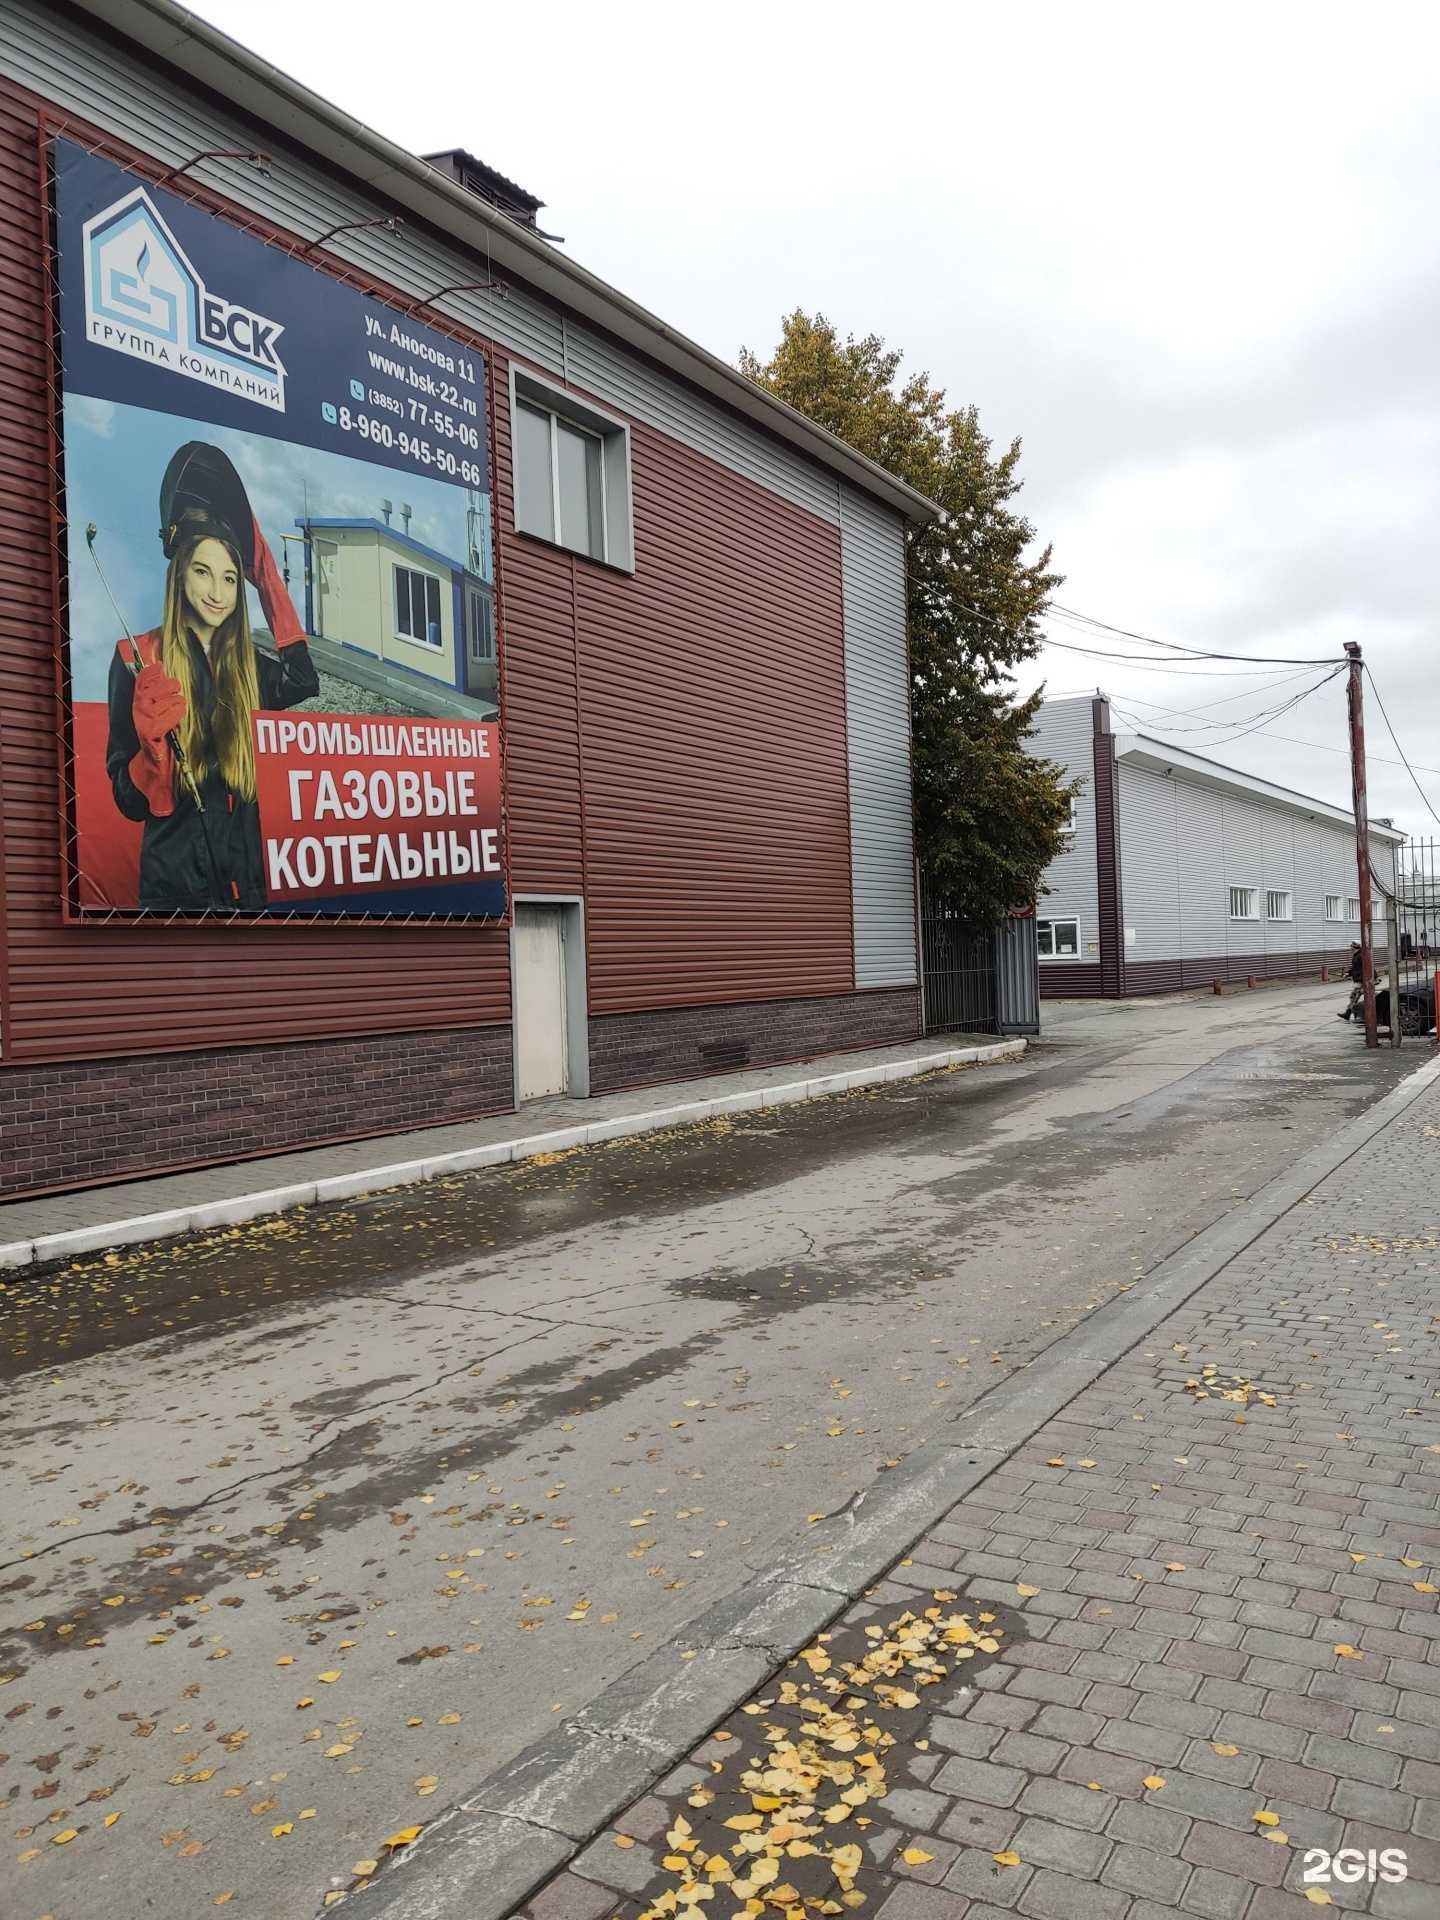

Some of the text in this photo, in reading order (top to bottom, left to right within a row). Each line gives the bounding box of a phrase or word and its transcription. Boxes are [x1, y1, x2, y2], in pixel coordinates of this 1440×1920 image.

[92, 321, 281, 405] ГРУППА КОМПАНИЙ
[204, 299, 276, 364] БСК
[364, 314, 476, 385] ул. Аносова 11
[367, 350, 477, 417] www.bsk-22.ru
[339, 405, 481, 487] 8-960-945-50-66
[368, 388, 479, 450] (3852) 77-55-06
[255, 719, 491, 758] ПРОМЫШЛЕННЫЕ
[287, 769, 479, 821] ГАЗОВЫЕ
[266, 828, 501, 891] КОТЕЛЬНЫЕ
